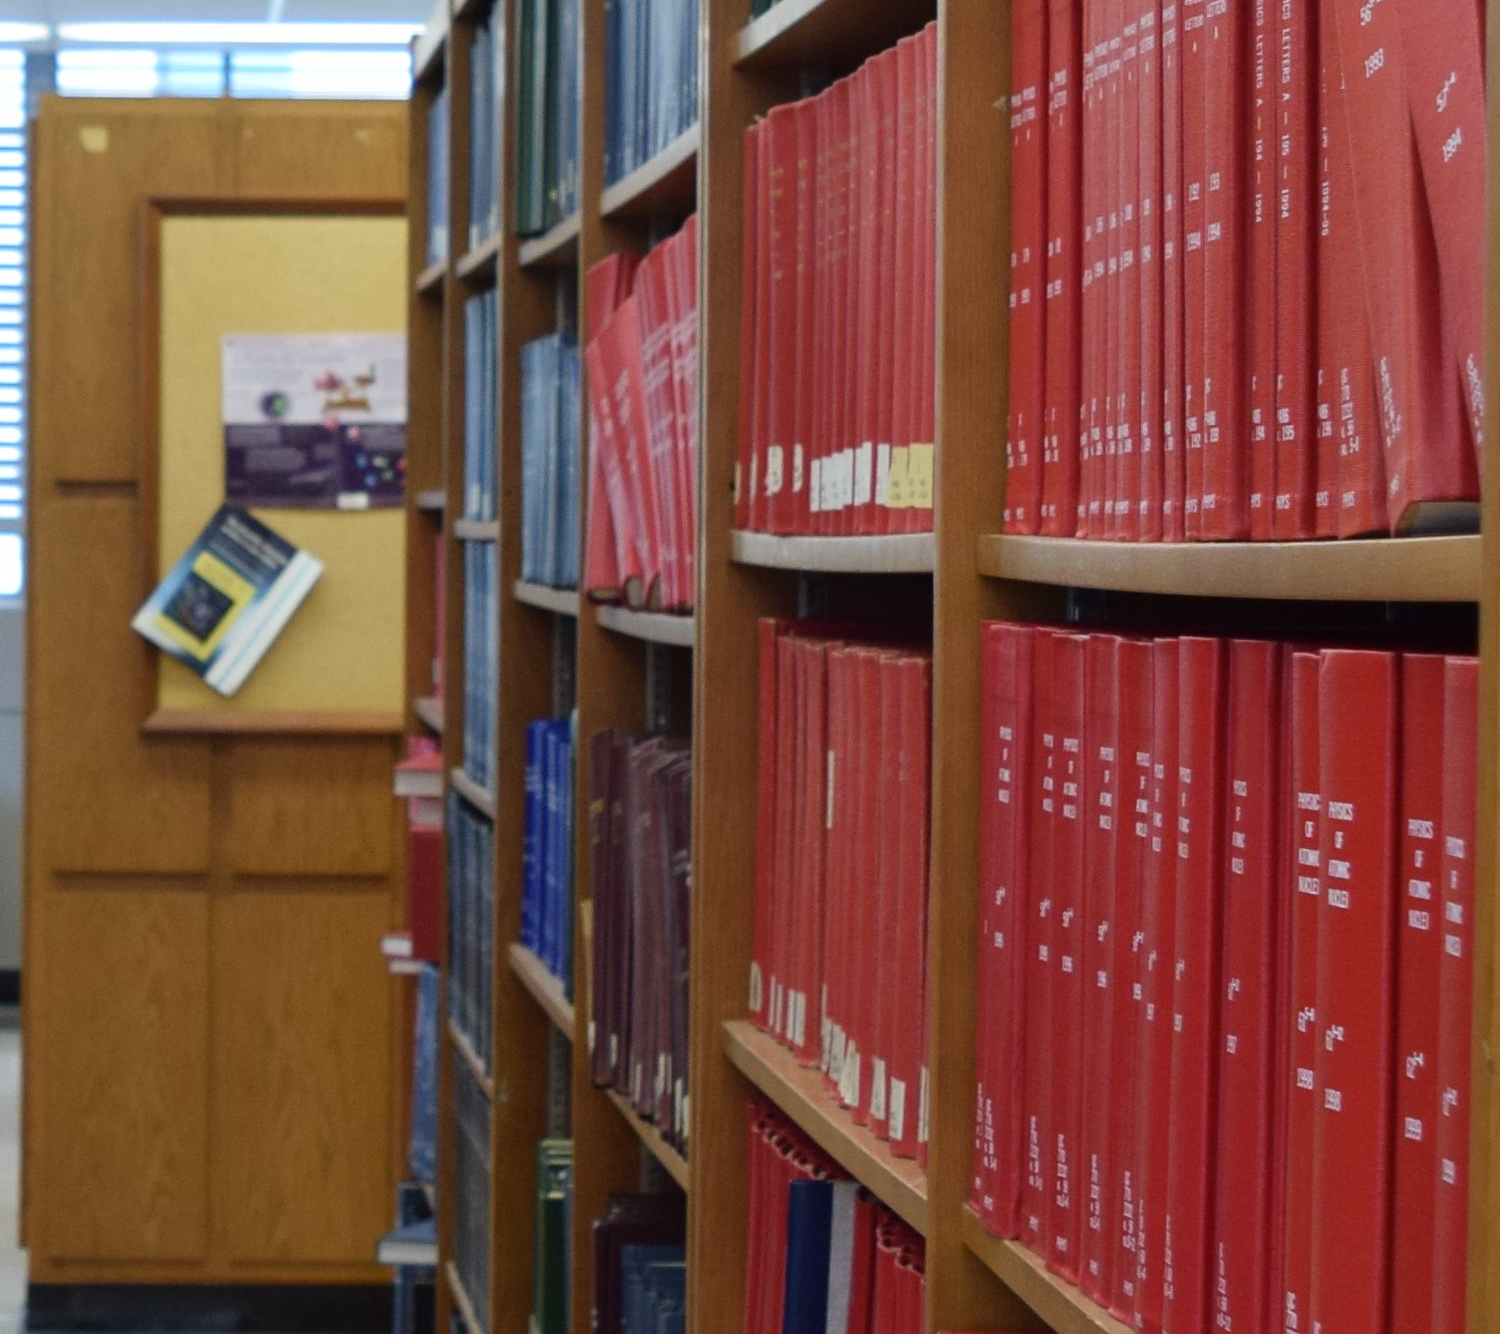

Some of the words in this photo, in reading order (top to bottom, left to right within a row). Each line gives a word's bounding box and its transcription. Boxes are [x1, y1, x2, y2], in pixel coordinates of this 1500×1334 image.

[1255, 34, 1264, 89] LETTERS
[1281, 27, 1291, 84] LETTERS
[1364, 48, 1385, 79] 1993
[1255, 99, 1263, 107] A
[1281, 92, 1291, 102] A
